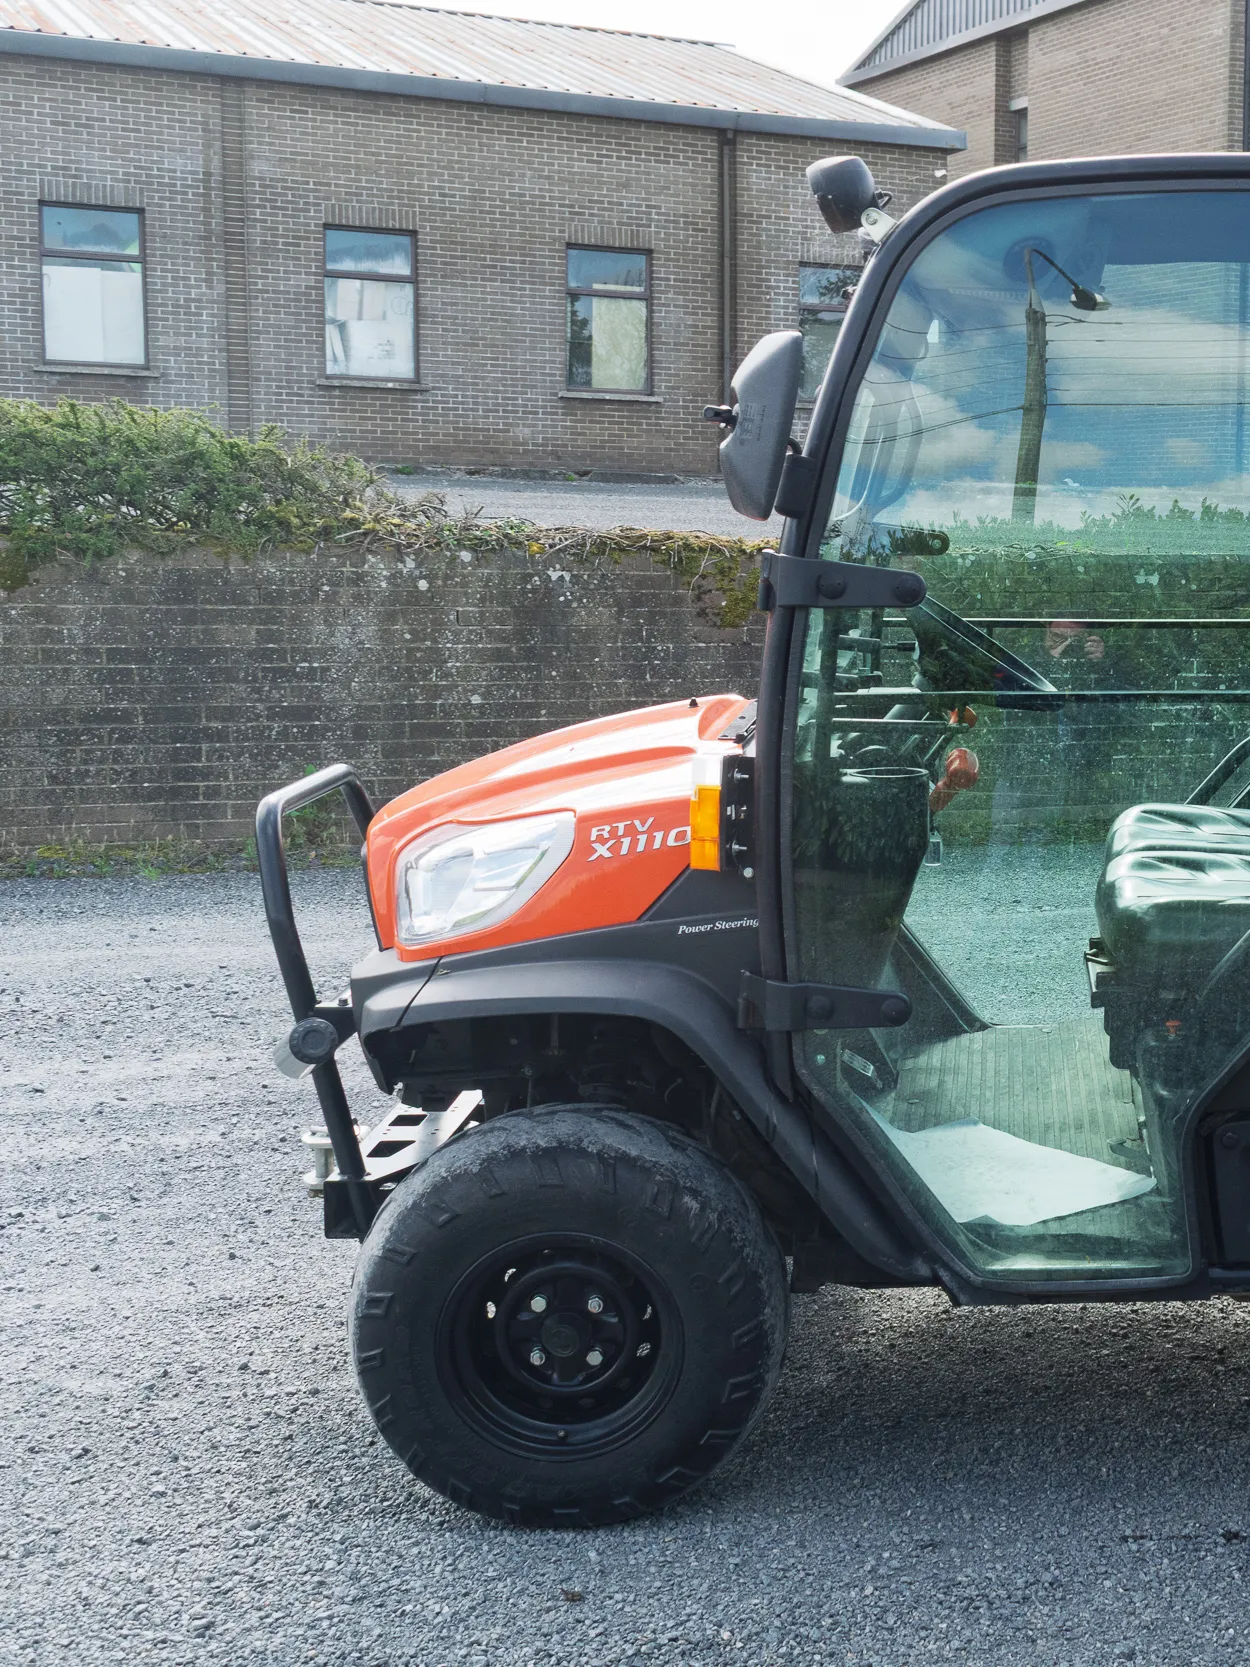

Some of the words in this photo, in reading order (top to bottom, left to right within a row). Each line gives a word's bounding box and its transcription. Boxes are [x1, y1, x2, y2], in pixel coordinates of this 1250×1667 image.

[590, 816, 655, 841] RTV
[586, 825, 691, 862] X1110
[677, 924, 714, 935] Power
[714, 917, 759, 930] Steering
